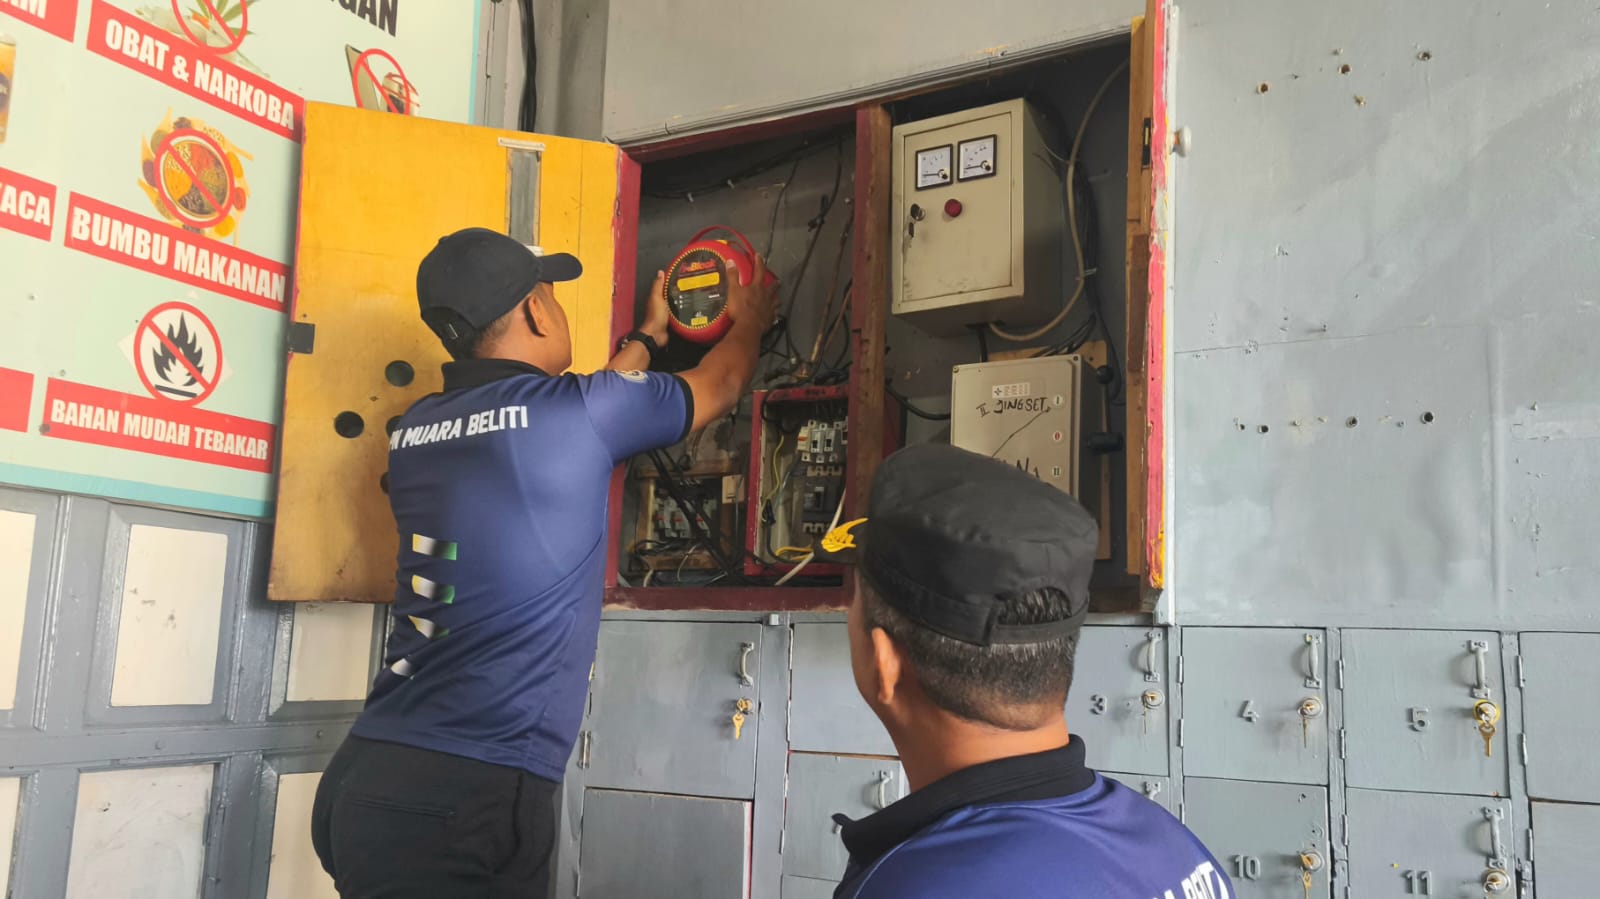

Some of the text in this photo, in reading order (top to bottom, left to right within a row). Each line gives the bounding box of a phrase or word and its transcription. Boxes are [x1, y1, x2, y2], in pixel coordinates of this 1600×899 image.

[105, 18, 294, 130] OBAT & NARKOBA
[0, 183, 51, 227] ACA
[71, 206, 286, 303] BUMBU MAKANAN
[51, 398, 269, 461] BAHAN MUDAH TEBAKAR
[401, 418, 463, 449] MUARA
[466, 405, 529, 436] BELITI
[1089, 693, 1108, 716] 3
[1240, 699, 1261, 724] 4
[1406, 704, 1431, 732] 5
[1232, 854, 1262, 881] 10
[1403, 870, 1433, 896] 11
